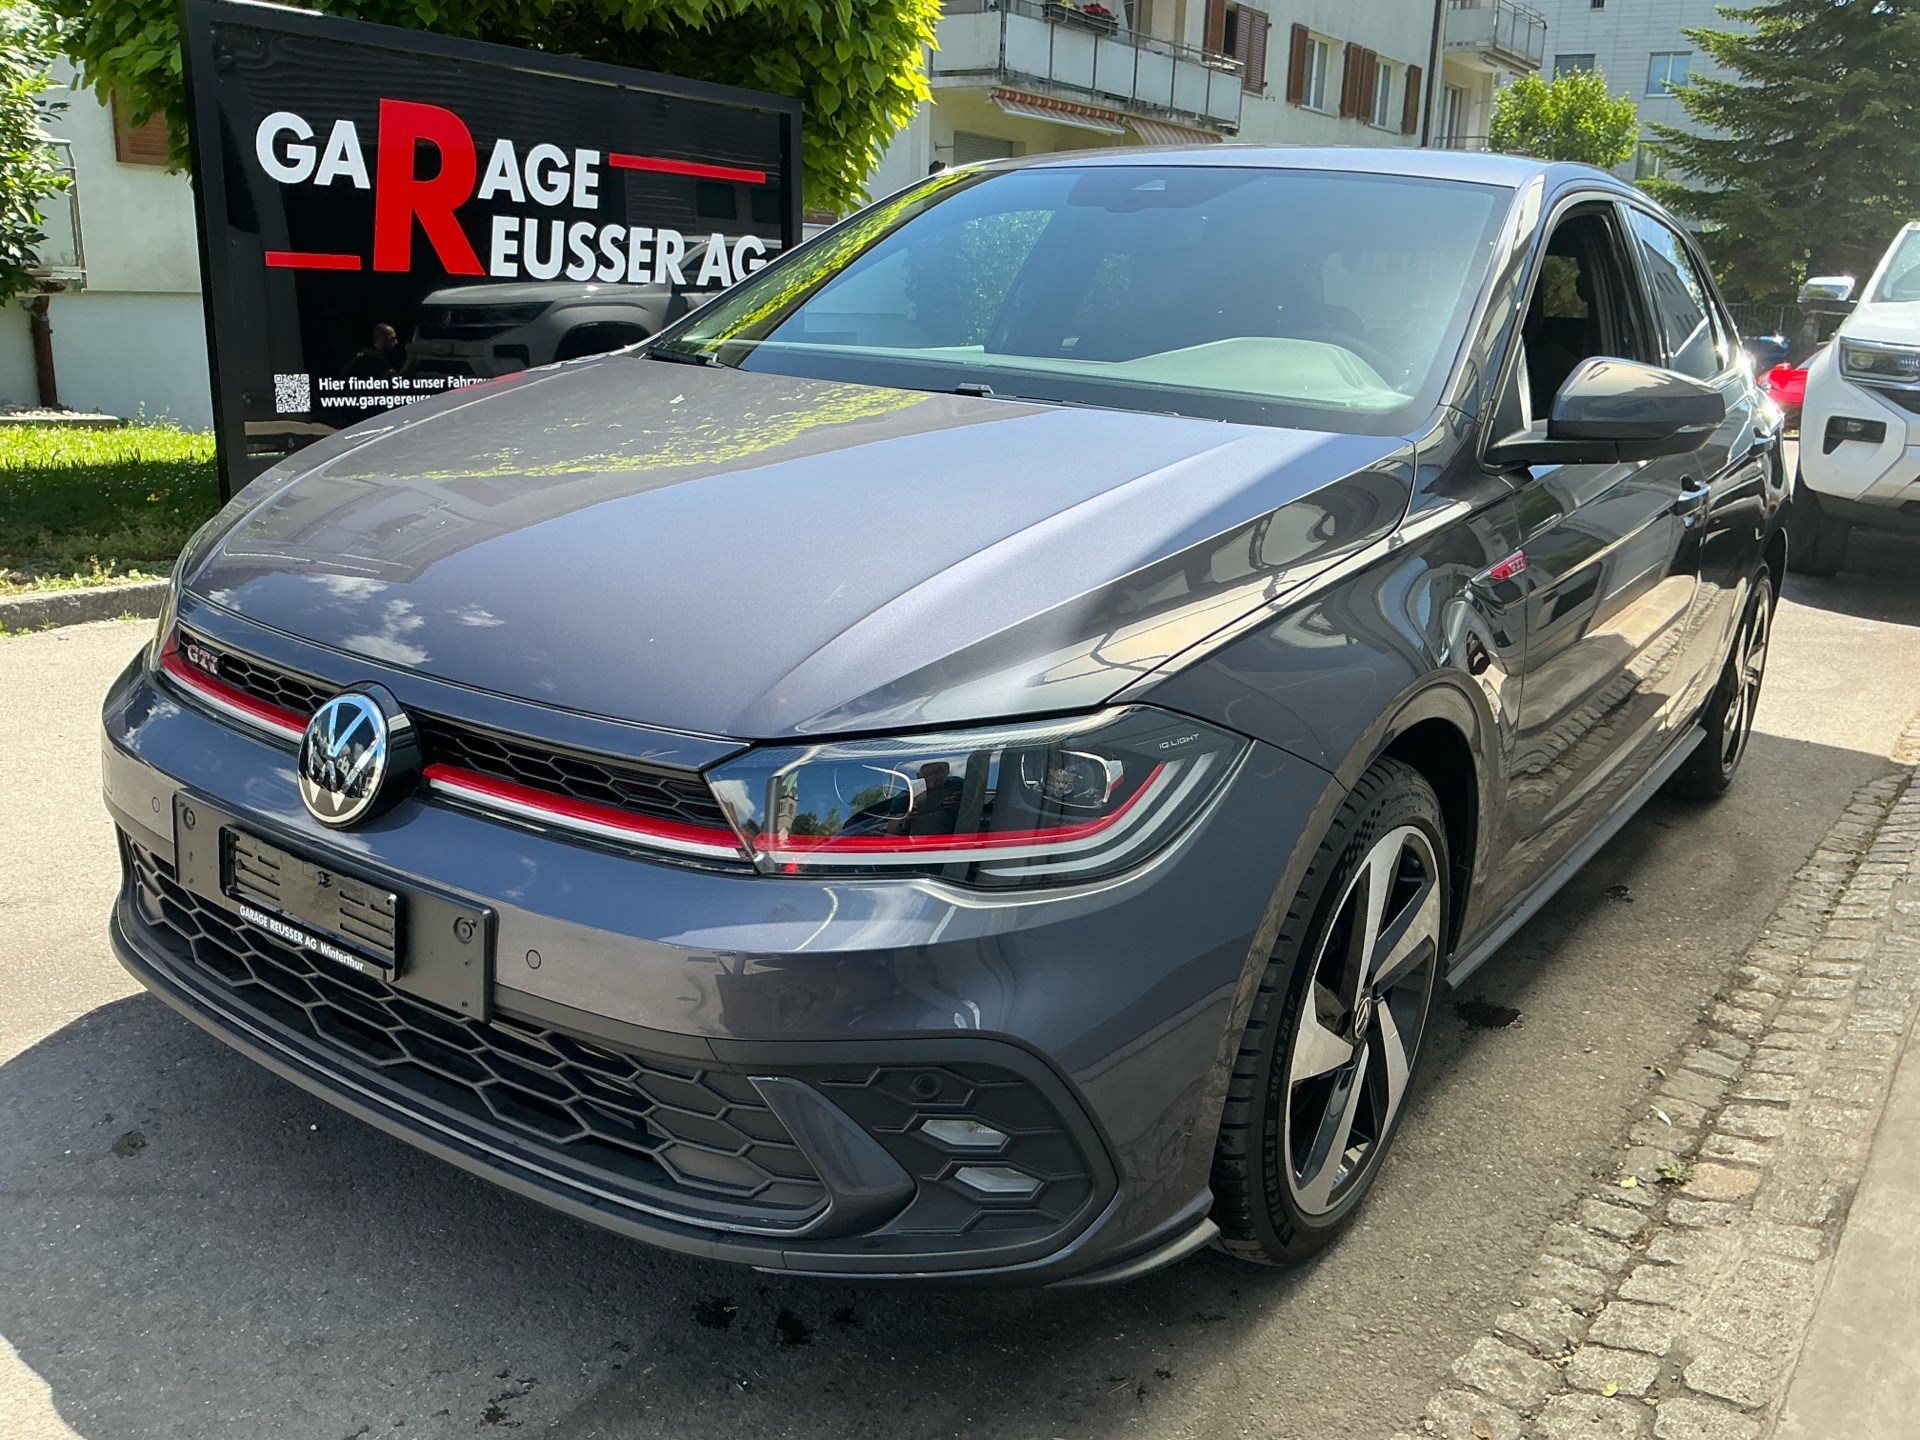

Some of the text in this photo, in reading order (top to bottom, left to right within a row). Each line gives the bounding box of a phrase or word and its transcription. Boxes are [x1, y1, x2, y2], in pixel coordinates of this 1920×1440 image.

[255, 98, 600, 276] GARAGE
[696, 233, 767, 287] AG
[319, 377, 344, 391] Hier
[348, 376, 389, 391] finden
[391, 376, 411, 390] Sie
[412, 378, 445, 389] unser
[187, 644, 219, 675] GTI
[1158, 733, 1200, 750] IQ.LIGHT
[239, 905, 365, 971] GARAGE REUSSER AG Winterthur
